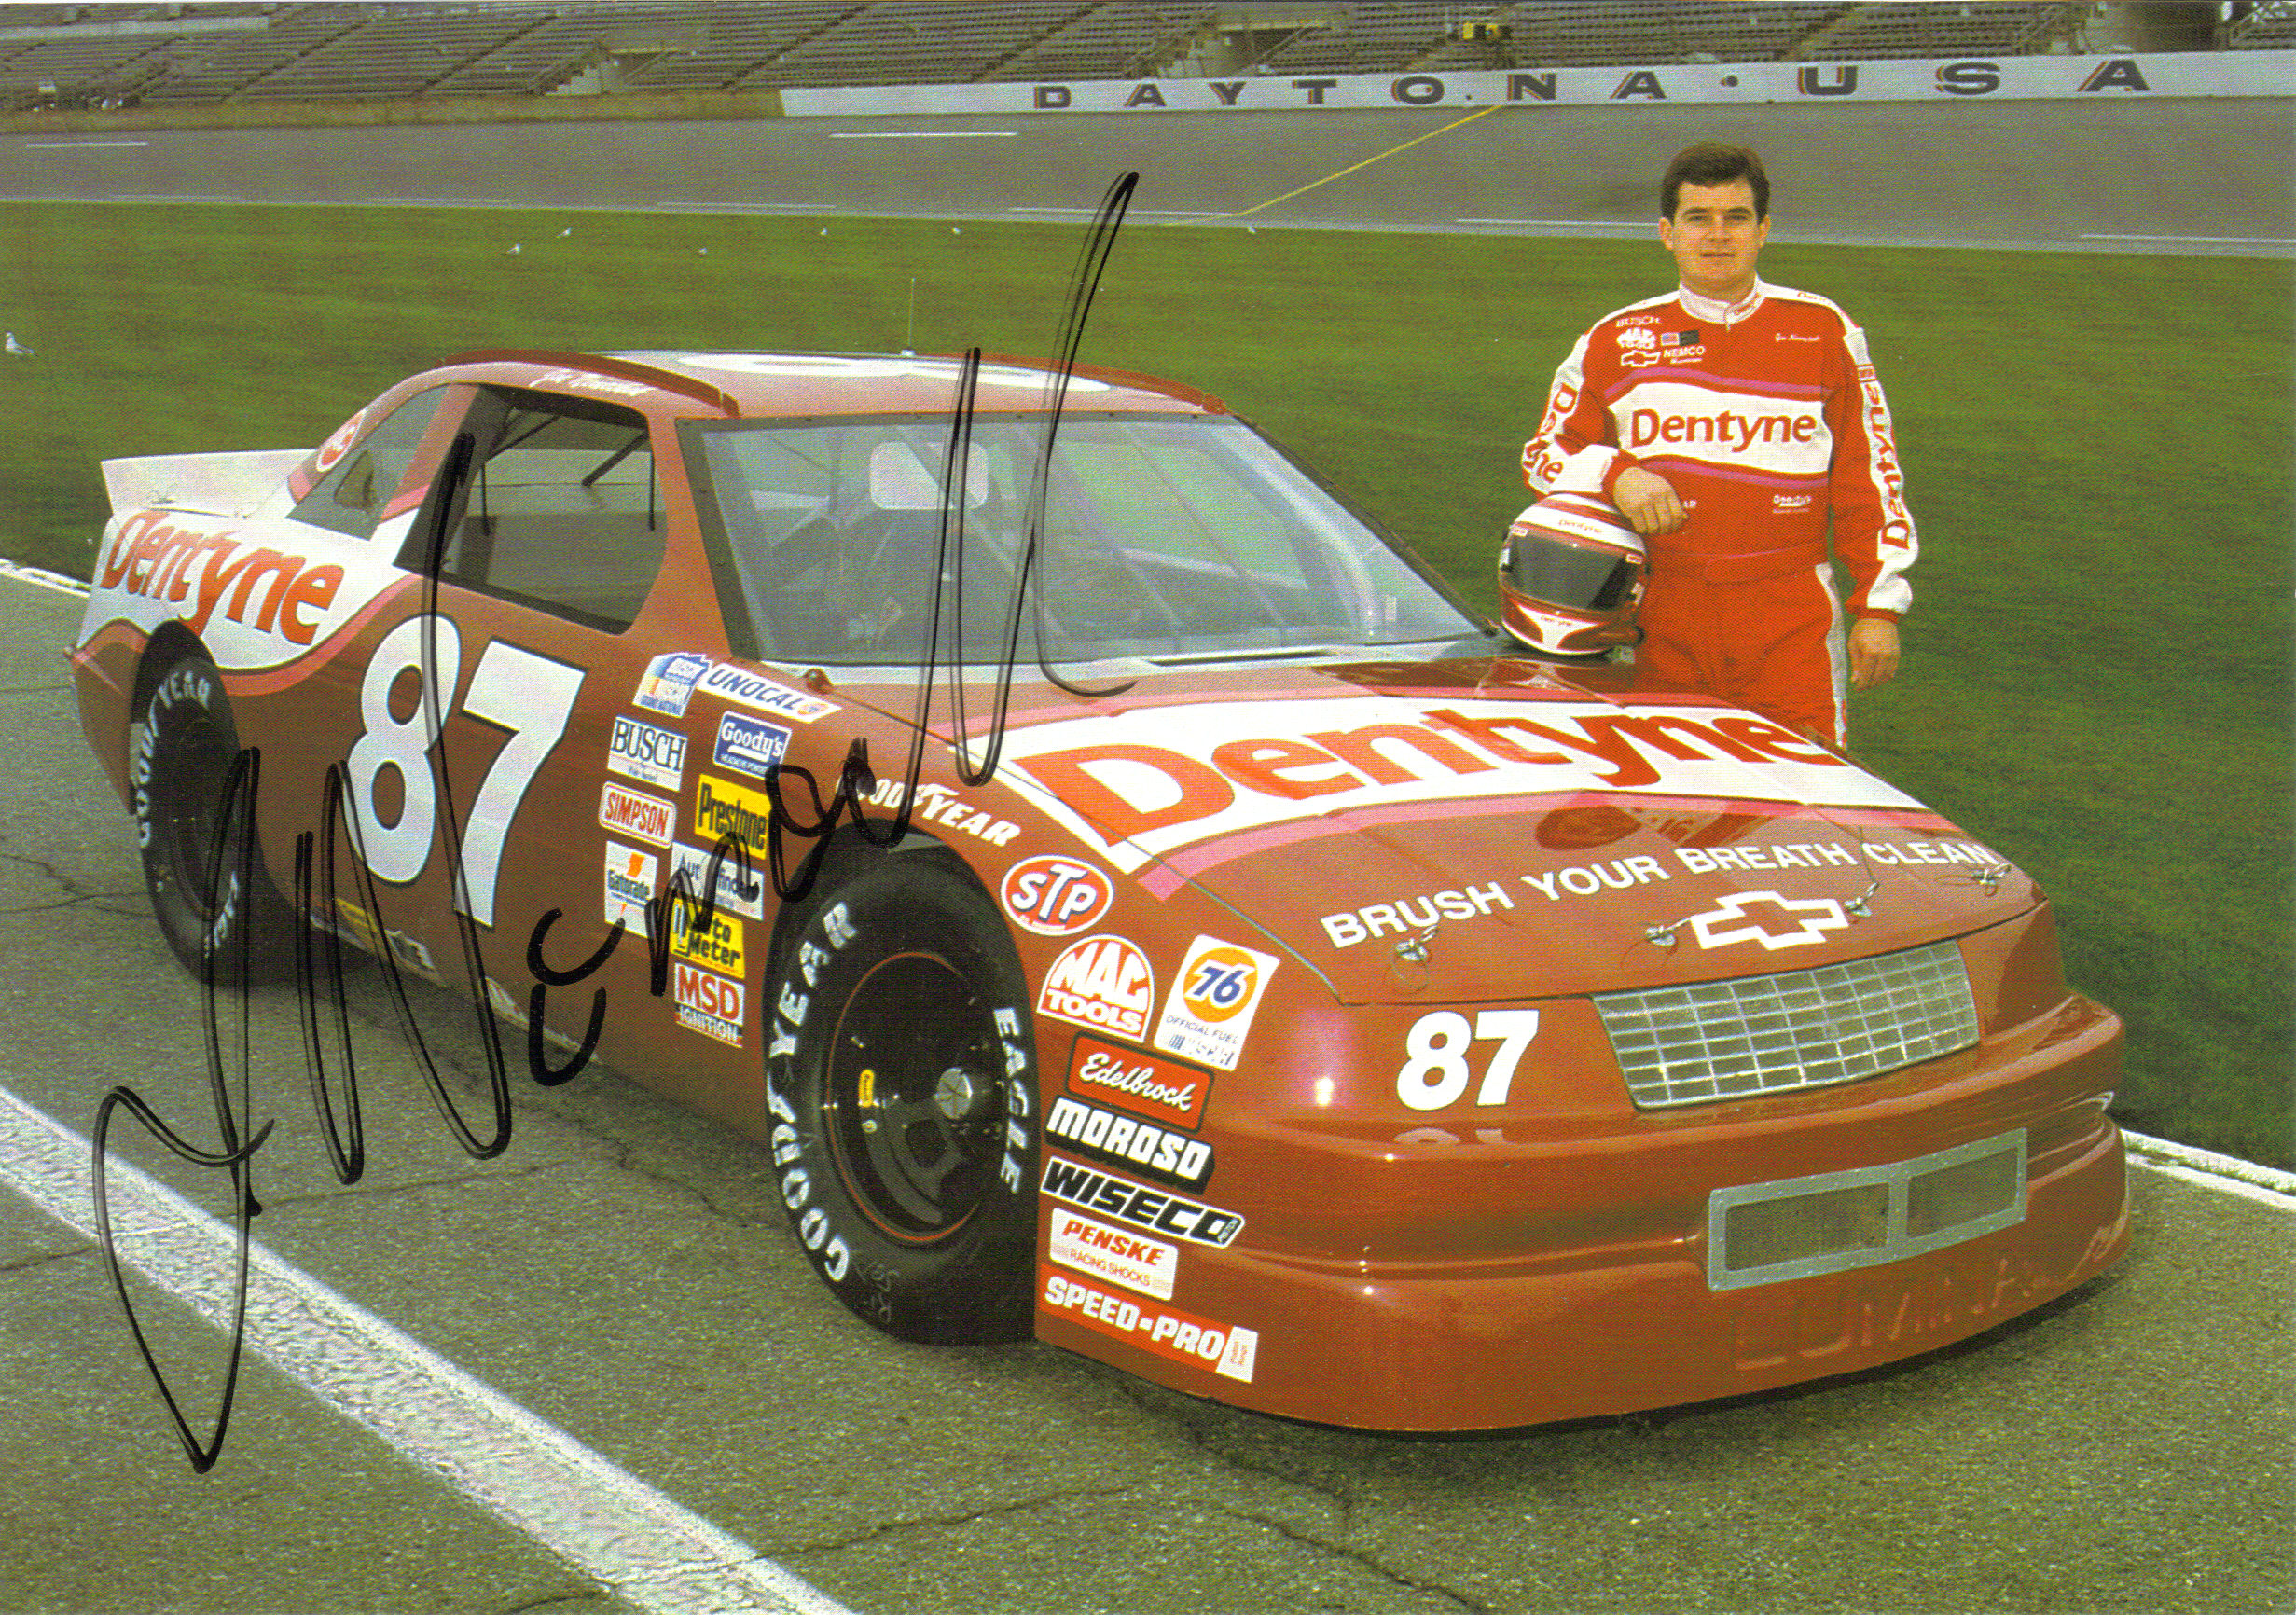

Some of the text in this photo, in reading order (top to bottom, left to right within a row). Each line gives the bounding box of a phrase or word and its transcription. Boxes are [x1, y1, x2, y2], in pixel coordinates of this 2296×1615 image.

[1663, 346, 1706, 358] NEMCO
[1631, 408, 1816, 453] Dentyne
[99, 510, 346, 647] Dentyne
[706, 668, 805, 711] UNOCAL
[611, 720, 685, 772] BUSCH
[721, 721, 784, 758] Goody's
[343, 614, 588, 929] 87
[1013, 708, 1849, 848] Dentyne
[606, 792, 670, 838] SIMPSON
[698, 782, 768, 851] Prestone
[1011, 863, 1098, 923] STP
[1320, 841, 2001, 949] BRUSH YOUR BREATH CLEAN
[688, 932, 740, 967] Meter
[1048, 940, 1150, 1015] MAC
[677, 964, 740, 1021] MSD
[1046, 987, 1143, 1033] TOOLS
[1189, 962, 1250, 1006] 76
[679, 1003, 740, 1042] IGNITION
[1166, 1015, 1238, 1044] OFFICIAL FUEL
[1079, 1052, 1197, 1111] Edelbrock
[1396, 1010, 1539, 1111] 87
[993, 1007, 1030, 1194] EAGLE
[1046, 1097, 1212, 1181] MOROSO
[1042, 1159, 1238, 1245] WISECO
[1061, 1219, 1166, 1266] PENSKE
[1069, 1249, 1151, 1287] RACING SHOCKS
[1044, 1275, 1226, 1360] SPEED-PRO
